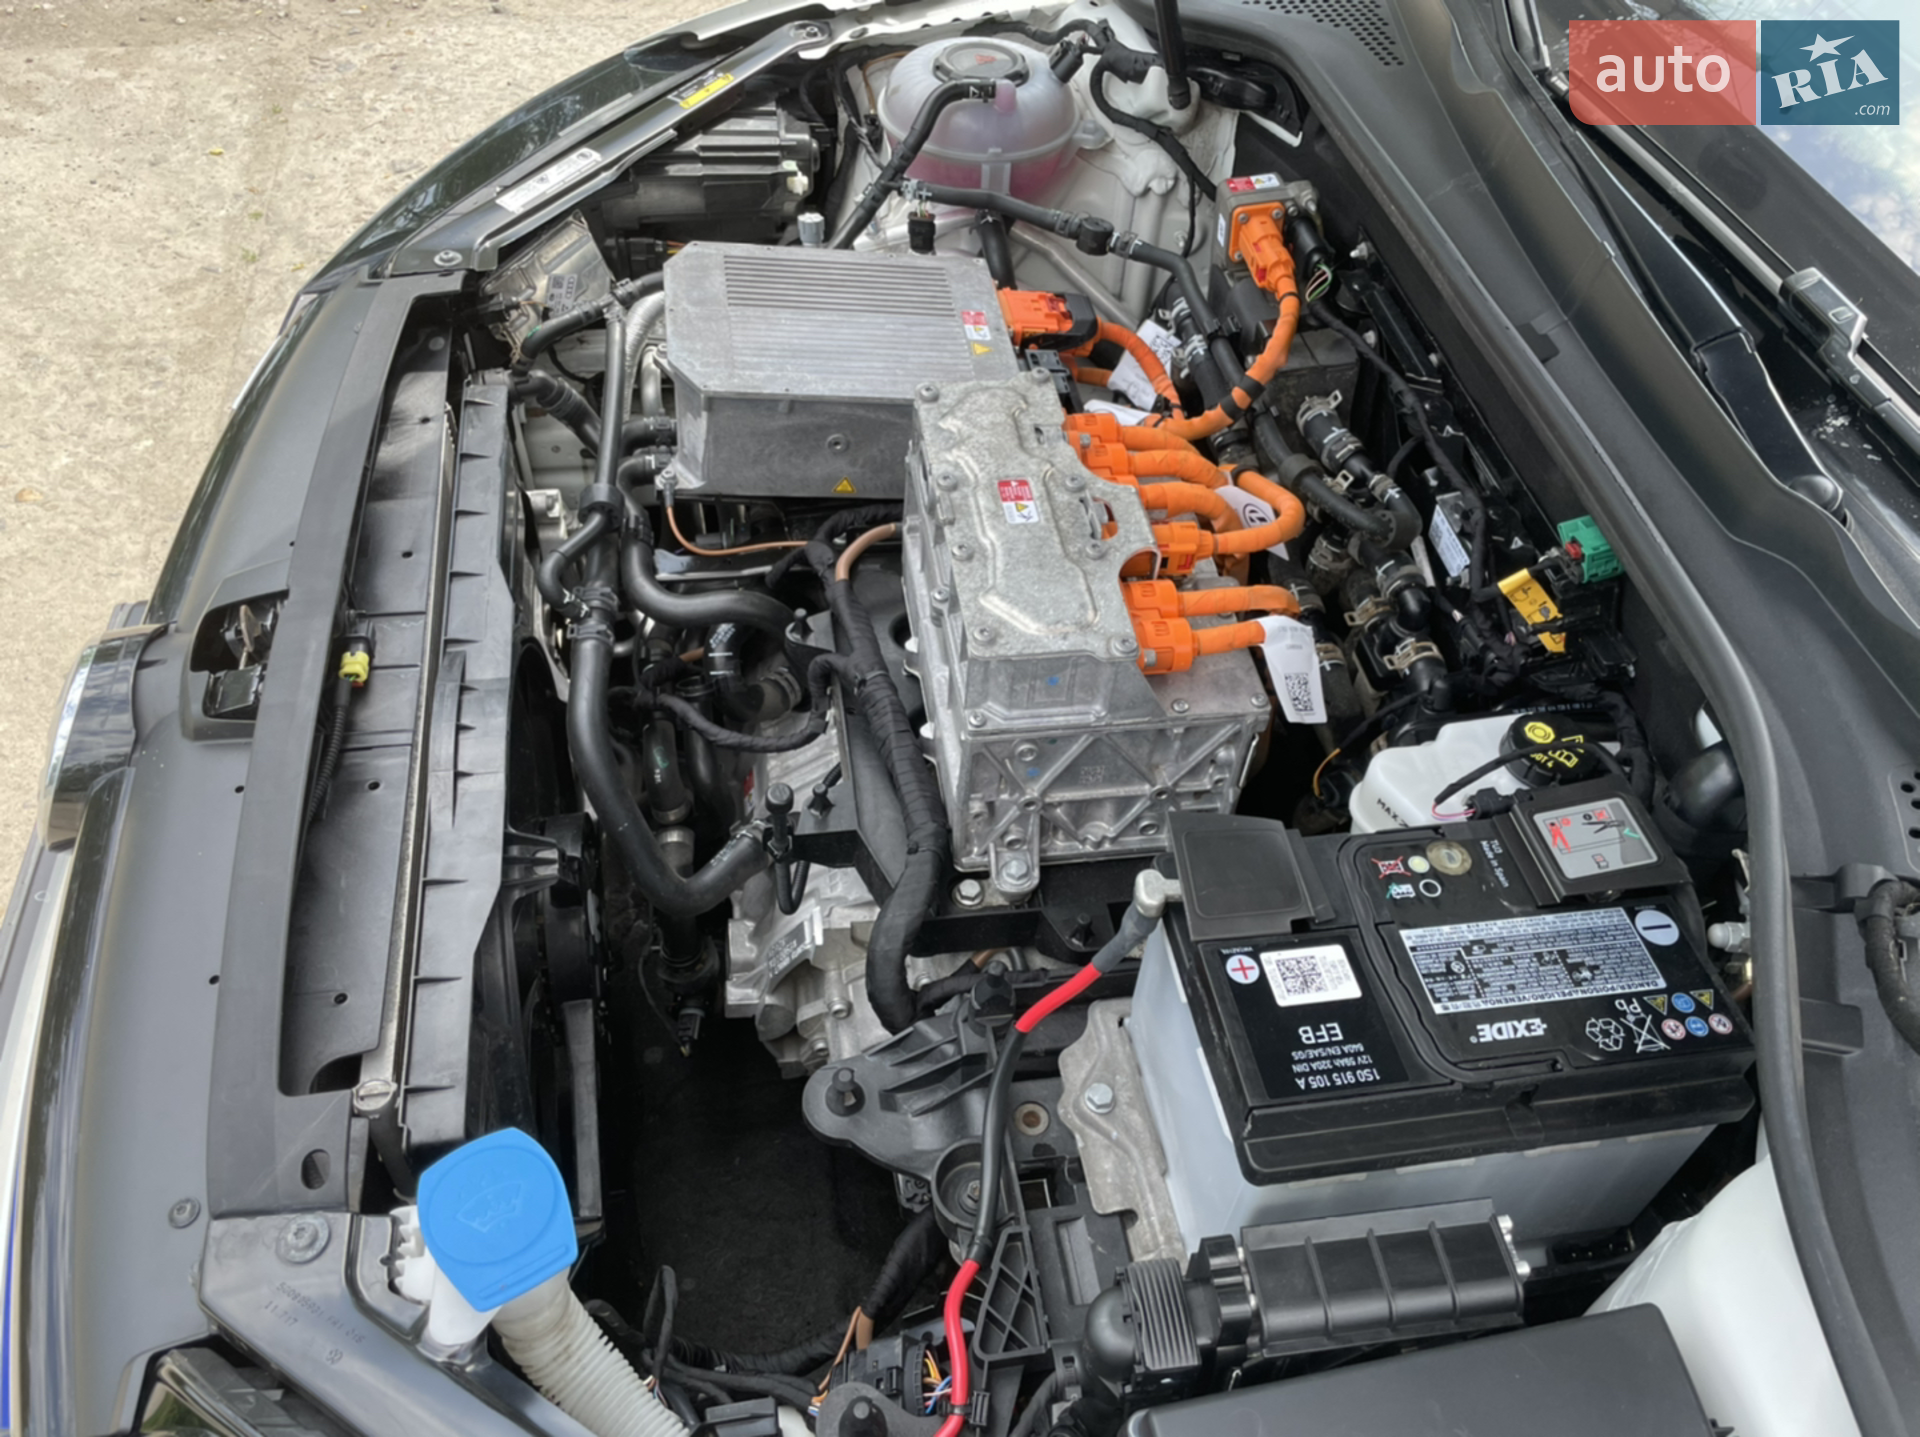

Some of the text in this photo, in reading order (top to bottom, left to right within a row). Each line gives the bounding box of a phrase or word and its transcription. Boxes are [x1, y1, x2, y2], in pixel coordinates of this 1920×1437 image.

[1376, 797, 1399, 823] MAX
[1480, 840, 1495, 859] Made
[1494, 867, 1509, 888] Spain
[1614, 997, 1642, 1014] Pb
[1298, 1022, 1343, 1044] EFB
[1477, 1017, 1547, 1043] EXIDE
[1357, 1055, 1373, 1065] 12V
[1291, 1063, 1310, 1074] DIN
[1295, 1076, 1306, 1091] A
[1308, 1074, 1331, 1089] 105
[1332, 1070, 1356, 1086] 915
